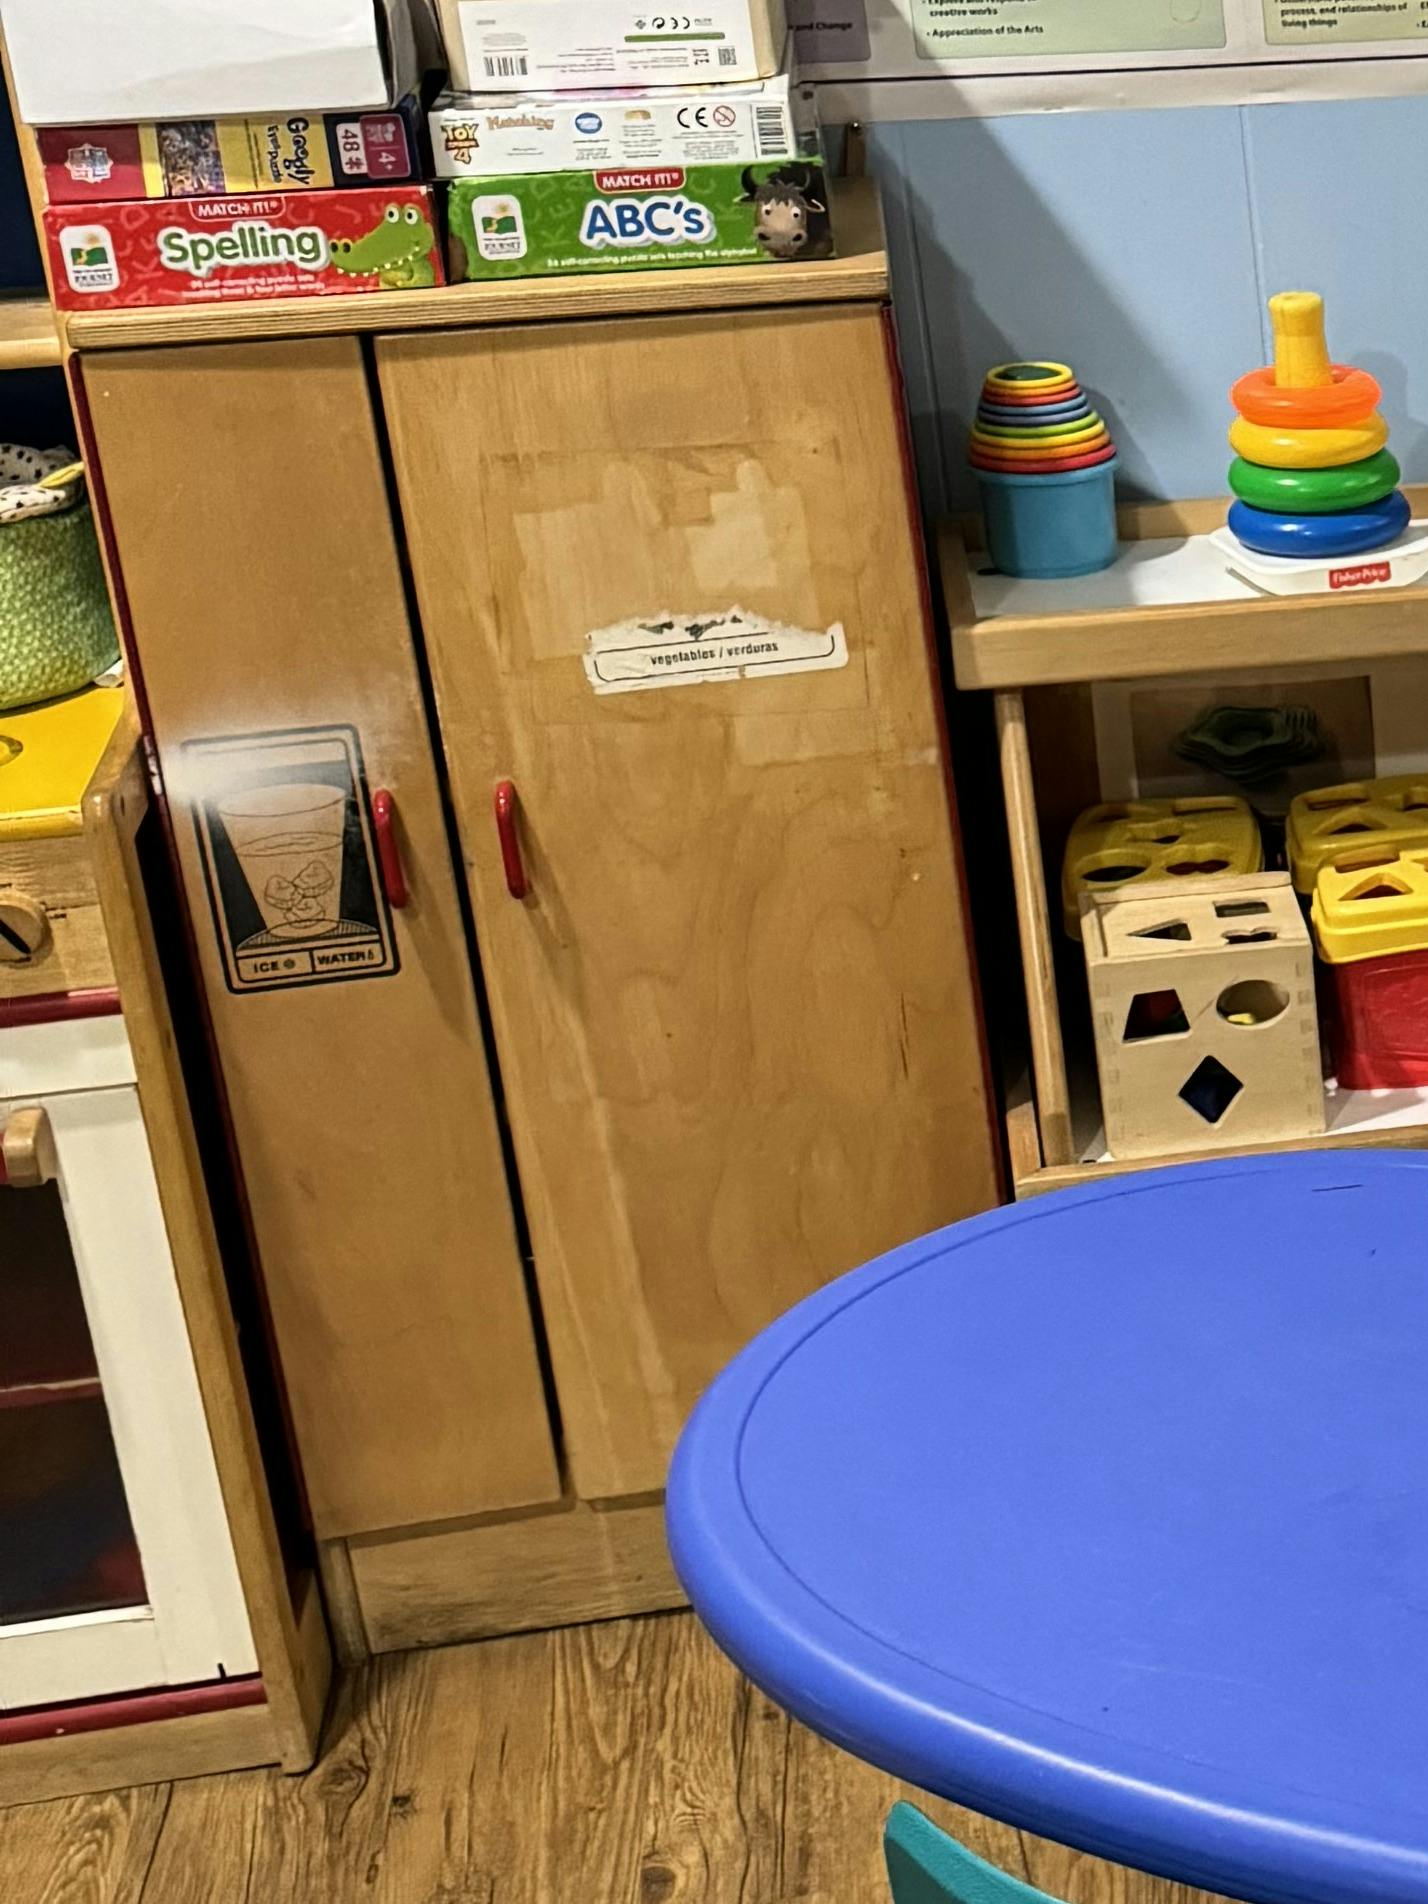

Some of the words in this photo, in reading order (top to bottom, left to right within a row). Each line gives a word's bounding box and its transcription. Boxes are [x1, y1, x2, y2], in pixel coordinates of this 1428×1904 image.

[677, 106, 708, 128] CE
[341, 129, 360, 152] 48
[441, 123, 479, 140] TOY
[284, 117, 314, 185] Googly
[454, 148, 471, 164] 4
[602, 173, 650, 188] MATCH
[198, 202, 249, 216] MATCH
[586, 201, 705, 240] ABC's
[162, 226, 321, 270] Spelling
[651, 648, 715, 665] vegetables
[727, 641, 779, 657] verduras
[254, 961, 279, 973] ICE
[317, 951, 366, 965] WATER
